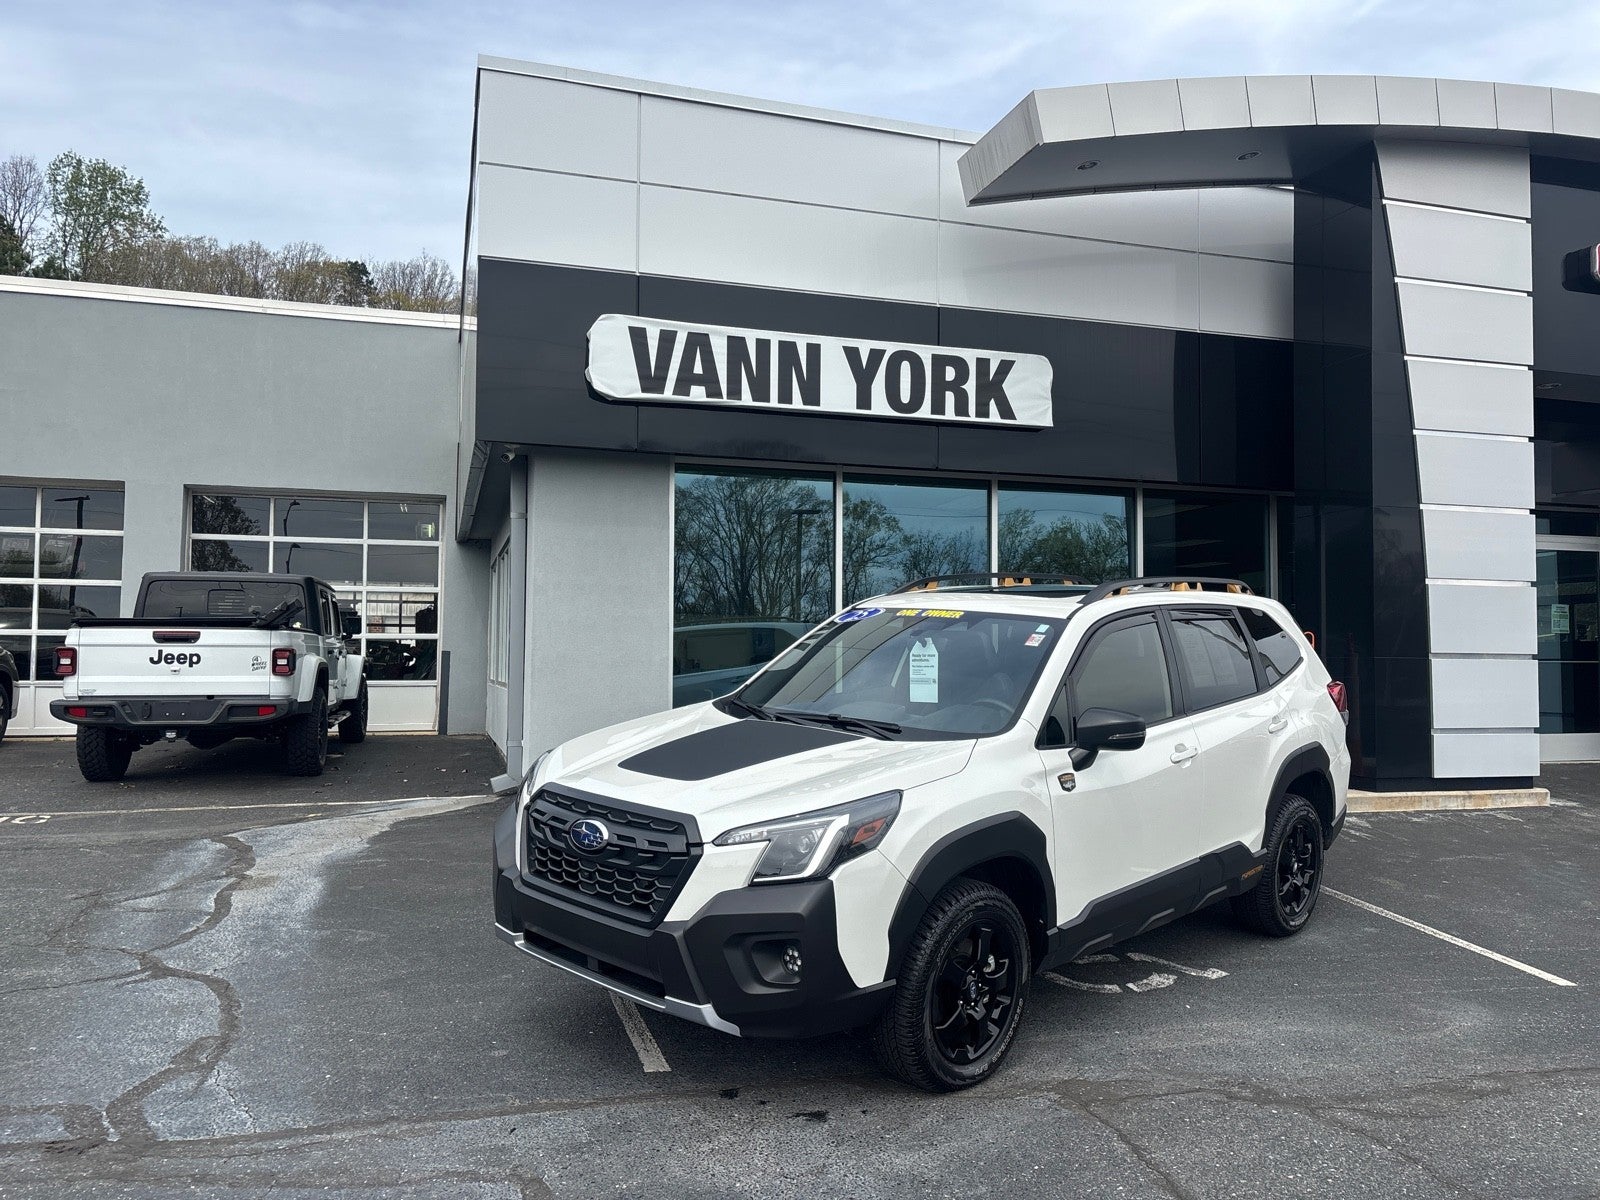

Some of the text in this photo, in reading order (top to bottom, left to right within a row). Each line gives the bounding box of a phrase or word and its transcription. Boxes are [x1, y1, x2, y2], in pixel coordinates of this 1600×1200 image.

[627, 325, 1018, 421] VANN YORK
[896, 609, 965, 619] ONE OWNER
[149, 649, 201, 668] Jeep
